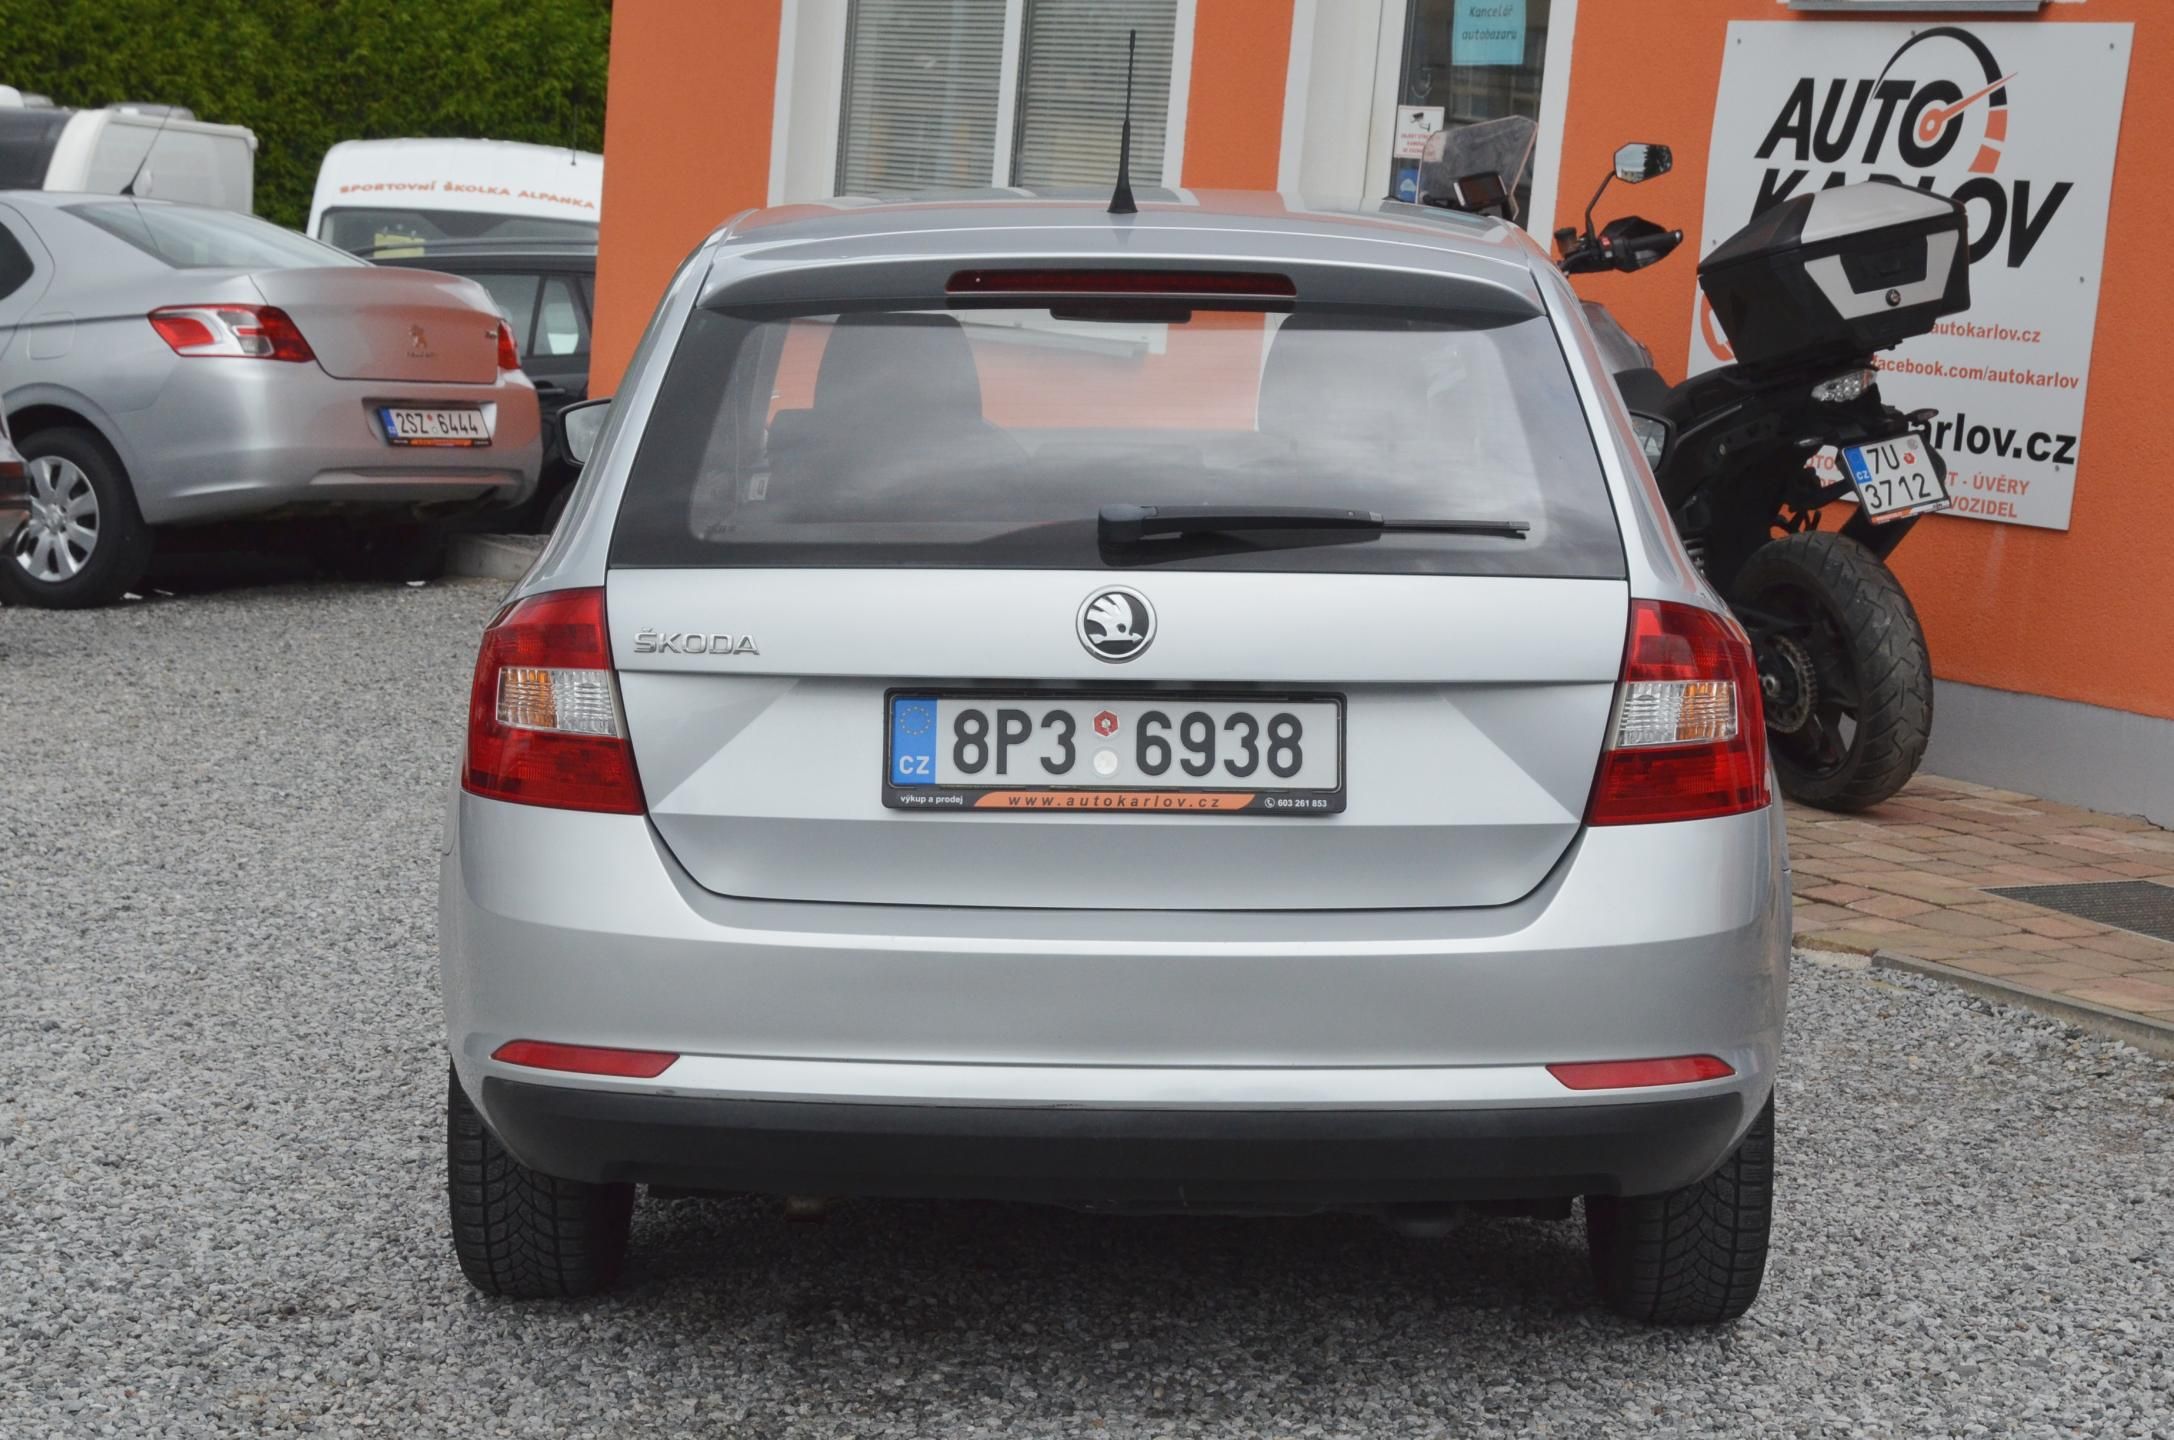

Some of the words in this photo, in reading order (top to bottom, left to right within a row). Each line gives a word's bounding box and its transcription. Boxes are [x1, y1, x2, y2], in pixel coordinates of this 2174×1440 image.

[1462, 28, 1518, 40] autobazaru
[1754, 77, 1964, 168] AUTO
[340, 180, 437, 193] SPORTOVNÍ
[443, 181, 511, 196] ŠKOLKA
[518, 190, 595, 209] ALPANKA
[395, 412, 429, 434] 2SZ
[437, 412, 479, 434] 6444
[1867, 443, 1900, 475] 7U
[1856, 471, 1870, 481] CZ
[1973, 471, 2030, 495] ÚVĚRY
[1865, 472, 1931, 509] 3712
[1949, 495, 2017, 519] VOZIDEL
[633, 626, 761, 656] ŠKODA
[952, 708, 1077, 776] 8P3
[1135, 710, 1304, 779] 6938
[899, 754, 930, 776] CZ
[900, 794, 926, 805] výkup
[936, 794, 963, 805] prodej
[1008, 794, 1221, 808] www.autokarlov.cz
[1277, 799, 1293, 808] 603
[1295, 799, 1310, 808] 261
[1312, 800, 1328, 809] 853
